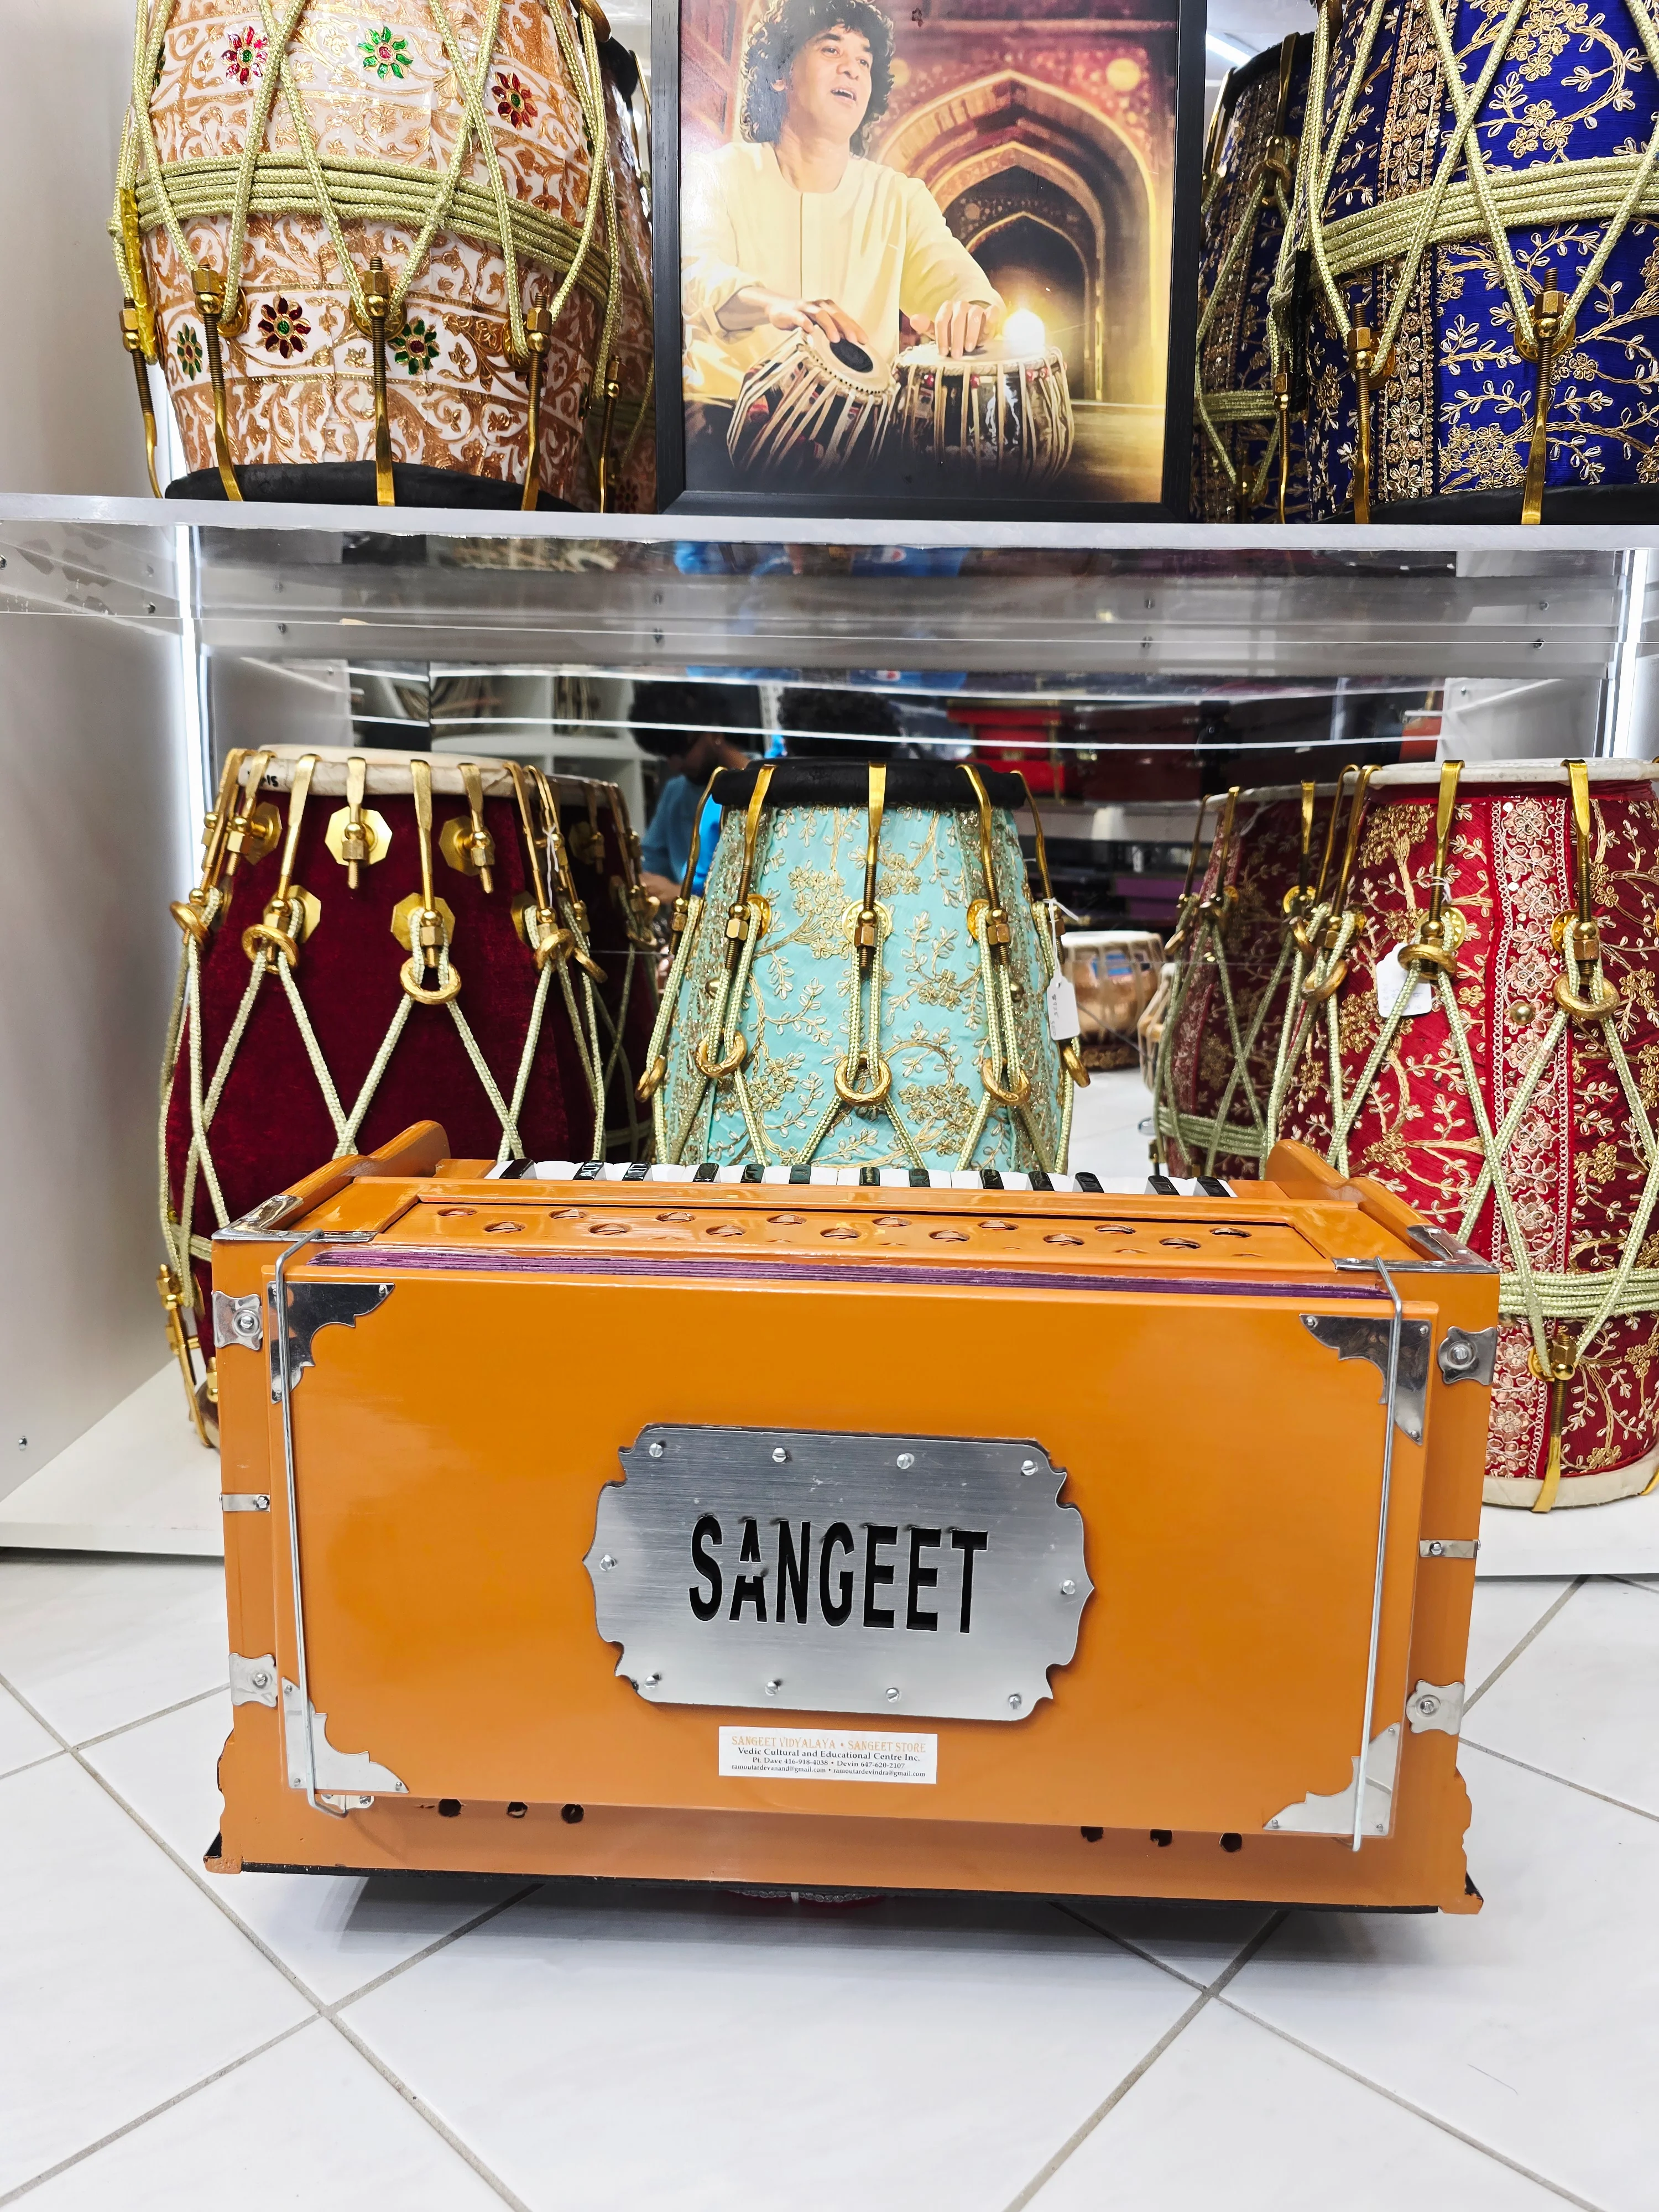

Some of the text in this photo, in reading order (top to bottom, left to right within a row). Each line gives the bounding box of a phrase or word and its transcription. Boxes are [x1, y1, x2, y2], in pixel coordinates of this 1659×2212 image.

[688, 1514, 989, 1634] SANGEET
[732, 1736, 926, 1753] SANGEET VIDYALAYA SANGEET STORE
[738, 1747, 761, 1755] Vedic
[764, 1748, 799, 1757] Cultural
[820, 1750, 871, 1760] Educational
[873, 1752, 902, 1761] Centre
